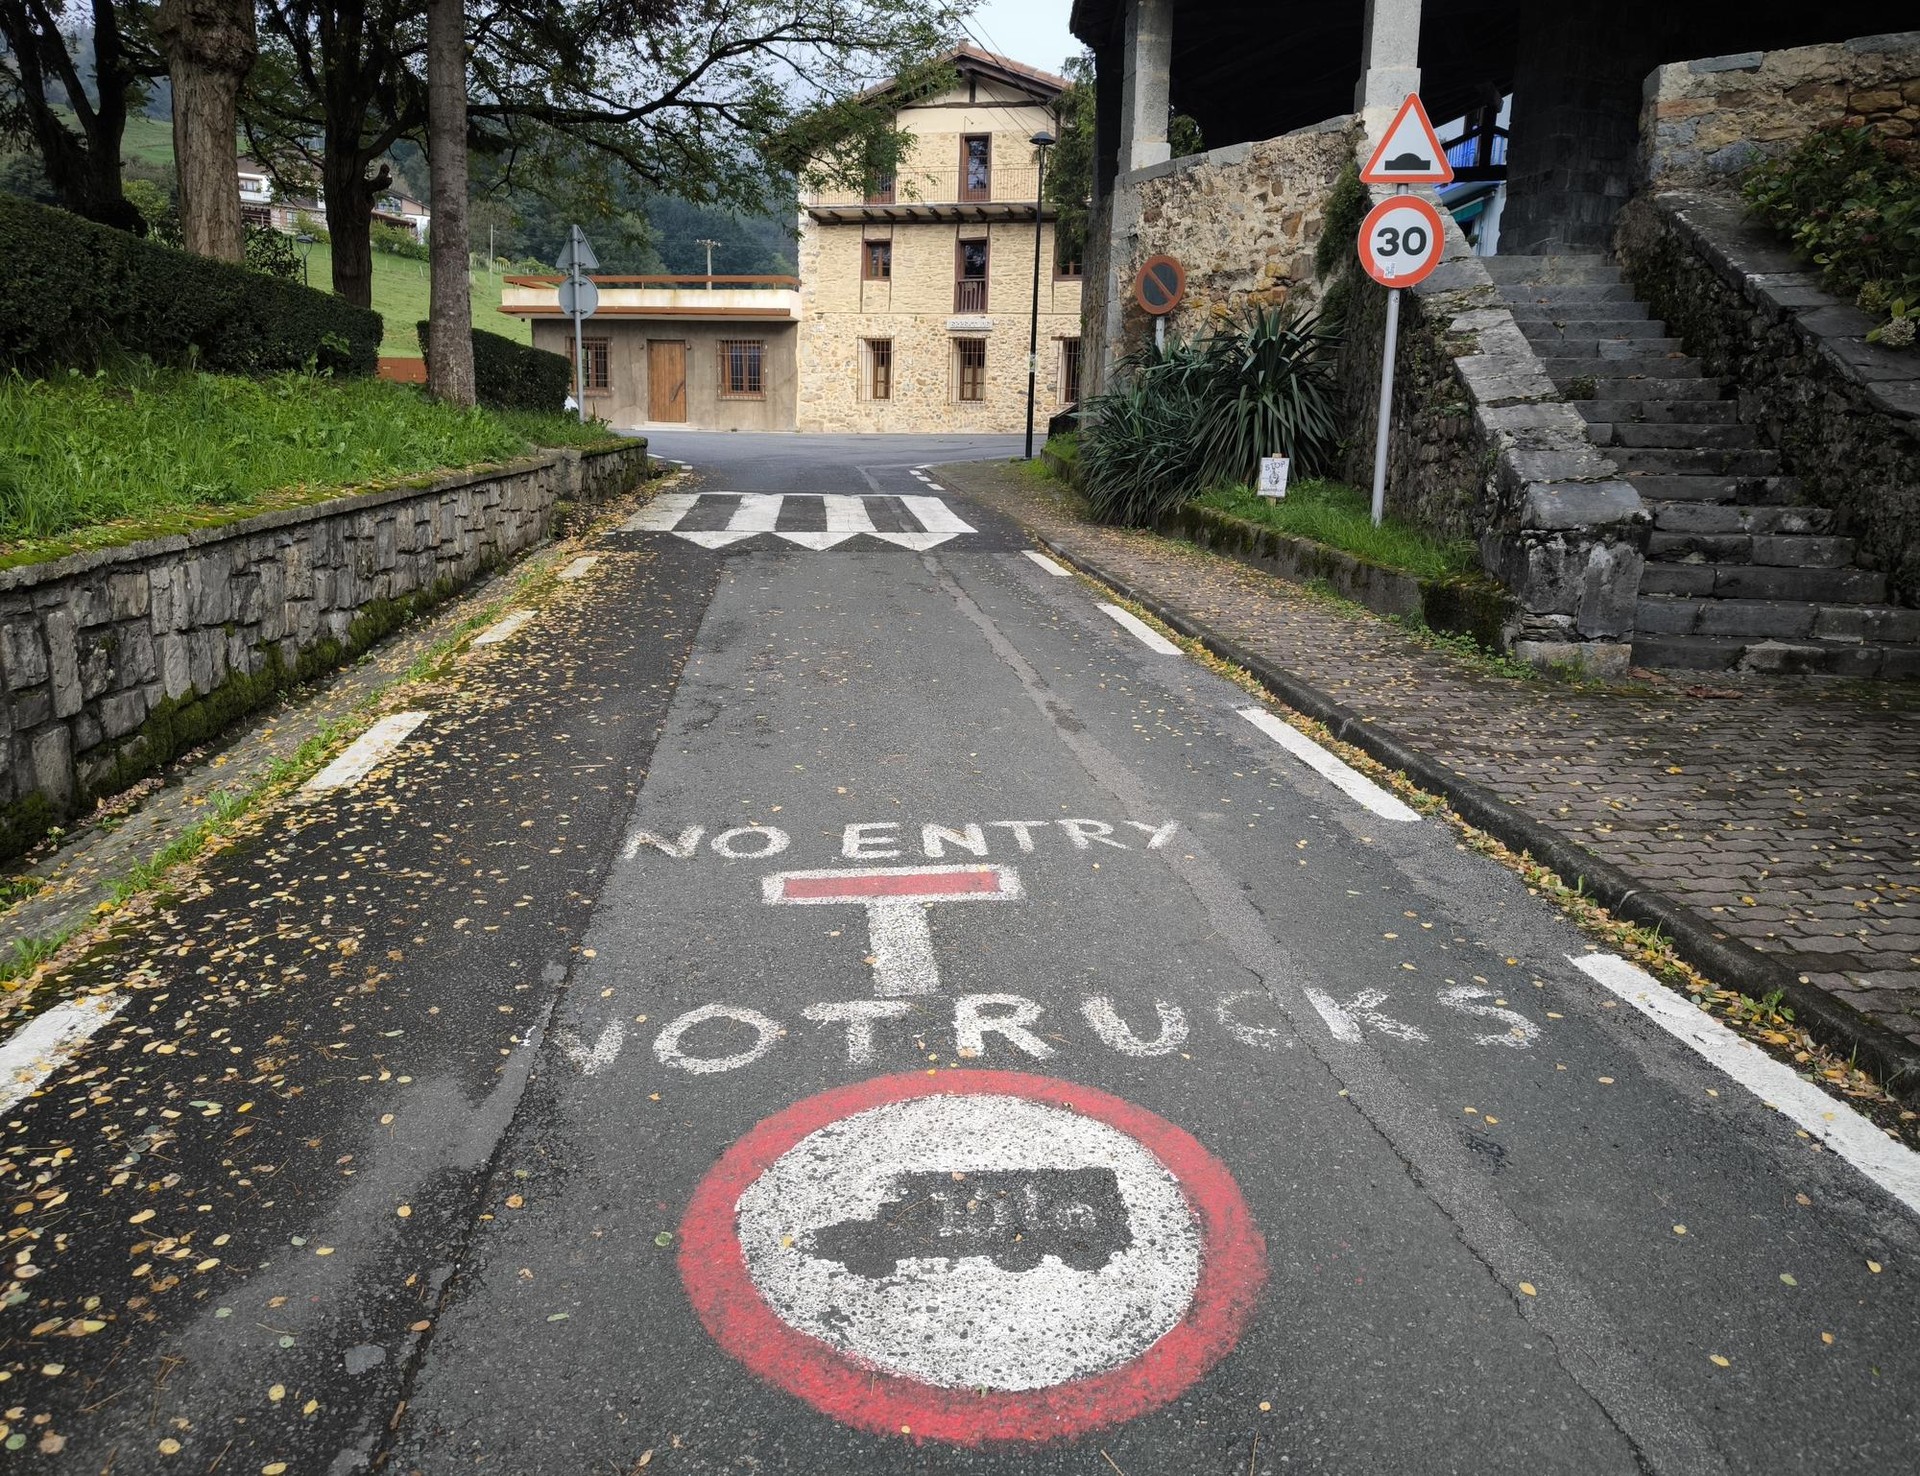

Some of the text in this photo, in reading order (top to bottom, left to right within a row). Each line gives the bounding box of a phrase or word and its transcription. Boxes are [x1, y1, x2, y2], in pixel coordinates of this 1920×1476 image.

[1376, 226, 1427, 257] 30
[1264, 460, 1286, 471] STOP
[622, 818, 1182, 858] NO ENTRY
[800, 985, 1541, 1064] TRUCKS
